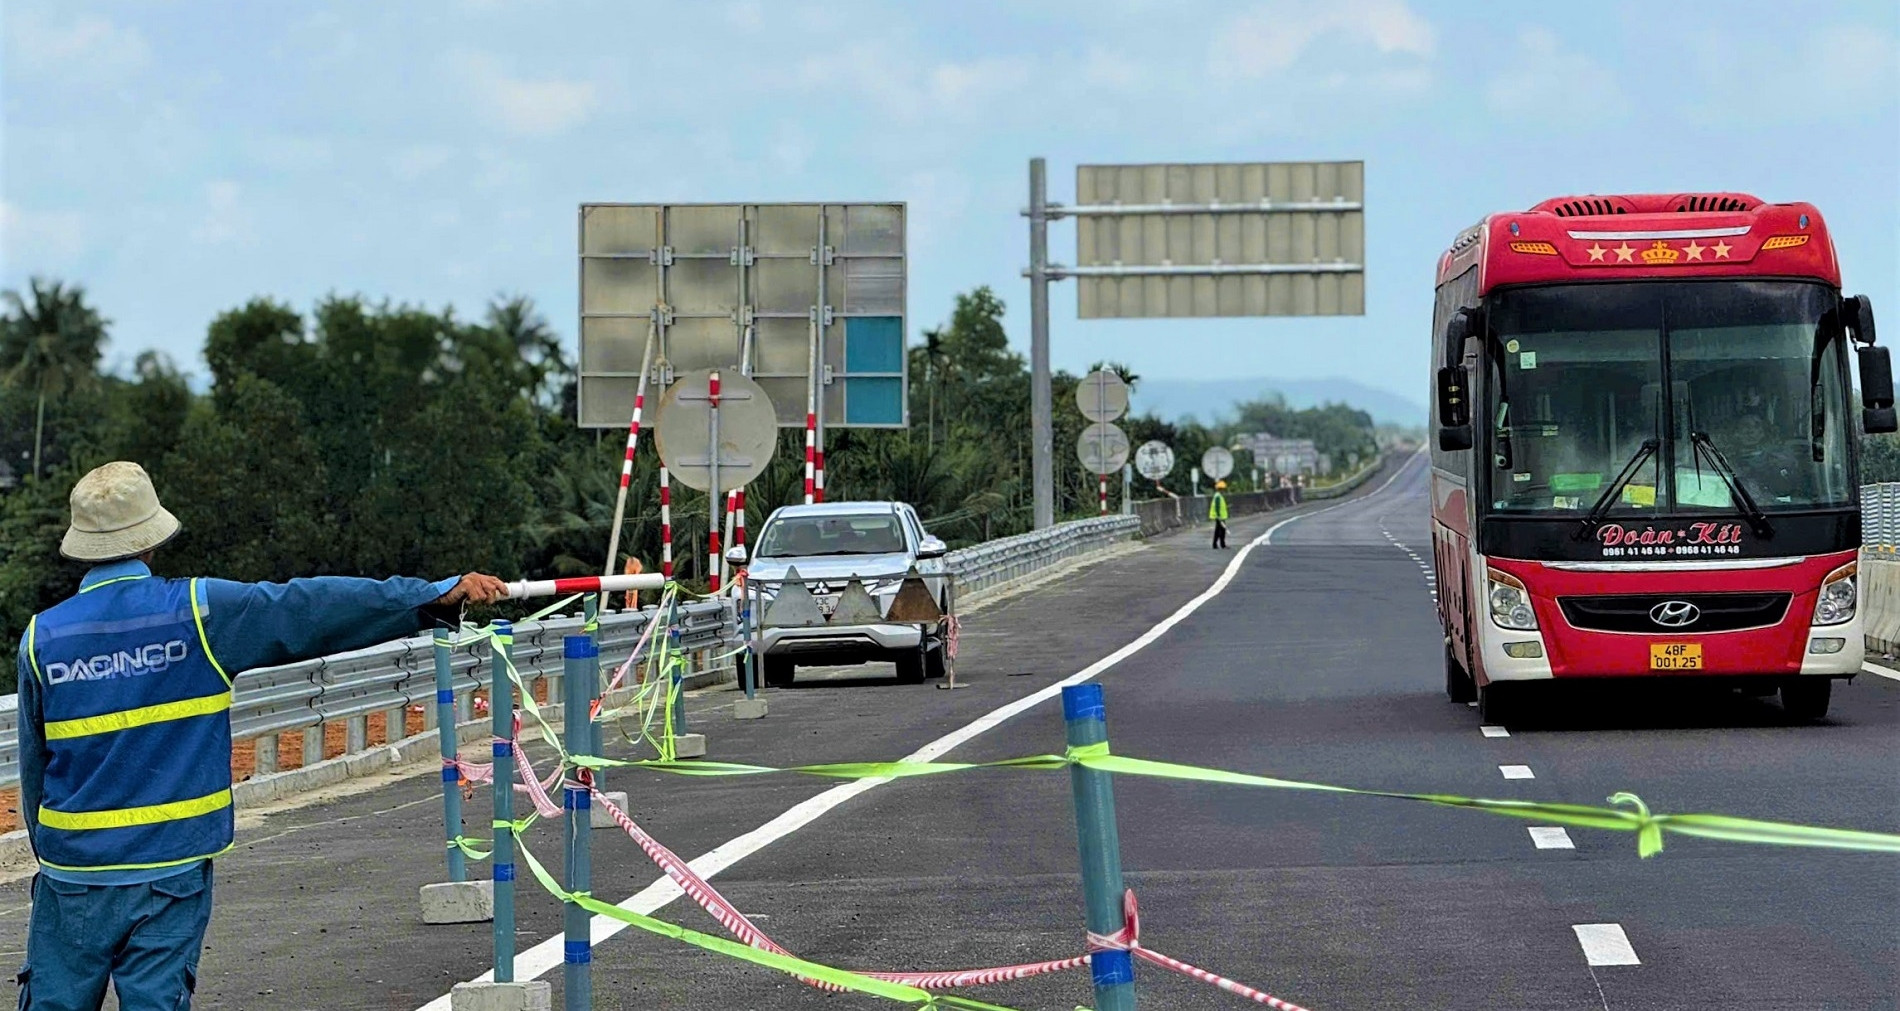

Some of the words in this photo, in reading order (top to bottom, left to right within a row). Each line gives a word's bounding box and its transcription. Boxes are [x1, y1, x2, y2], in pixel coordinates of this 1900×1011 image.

[1597, 524, 1675, 546] Đoàn
[1687, 522, 1742, 544] Kết
[1627, 547, 1639, 556] 41
[1701, 545, 1712, 554] 41
[1665, 645, 1687, 655] 48F
[45, 639, 188, 686] DACINCO
[1656, 657, 1697, 668] 001.25
